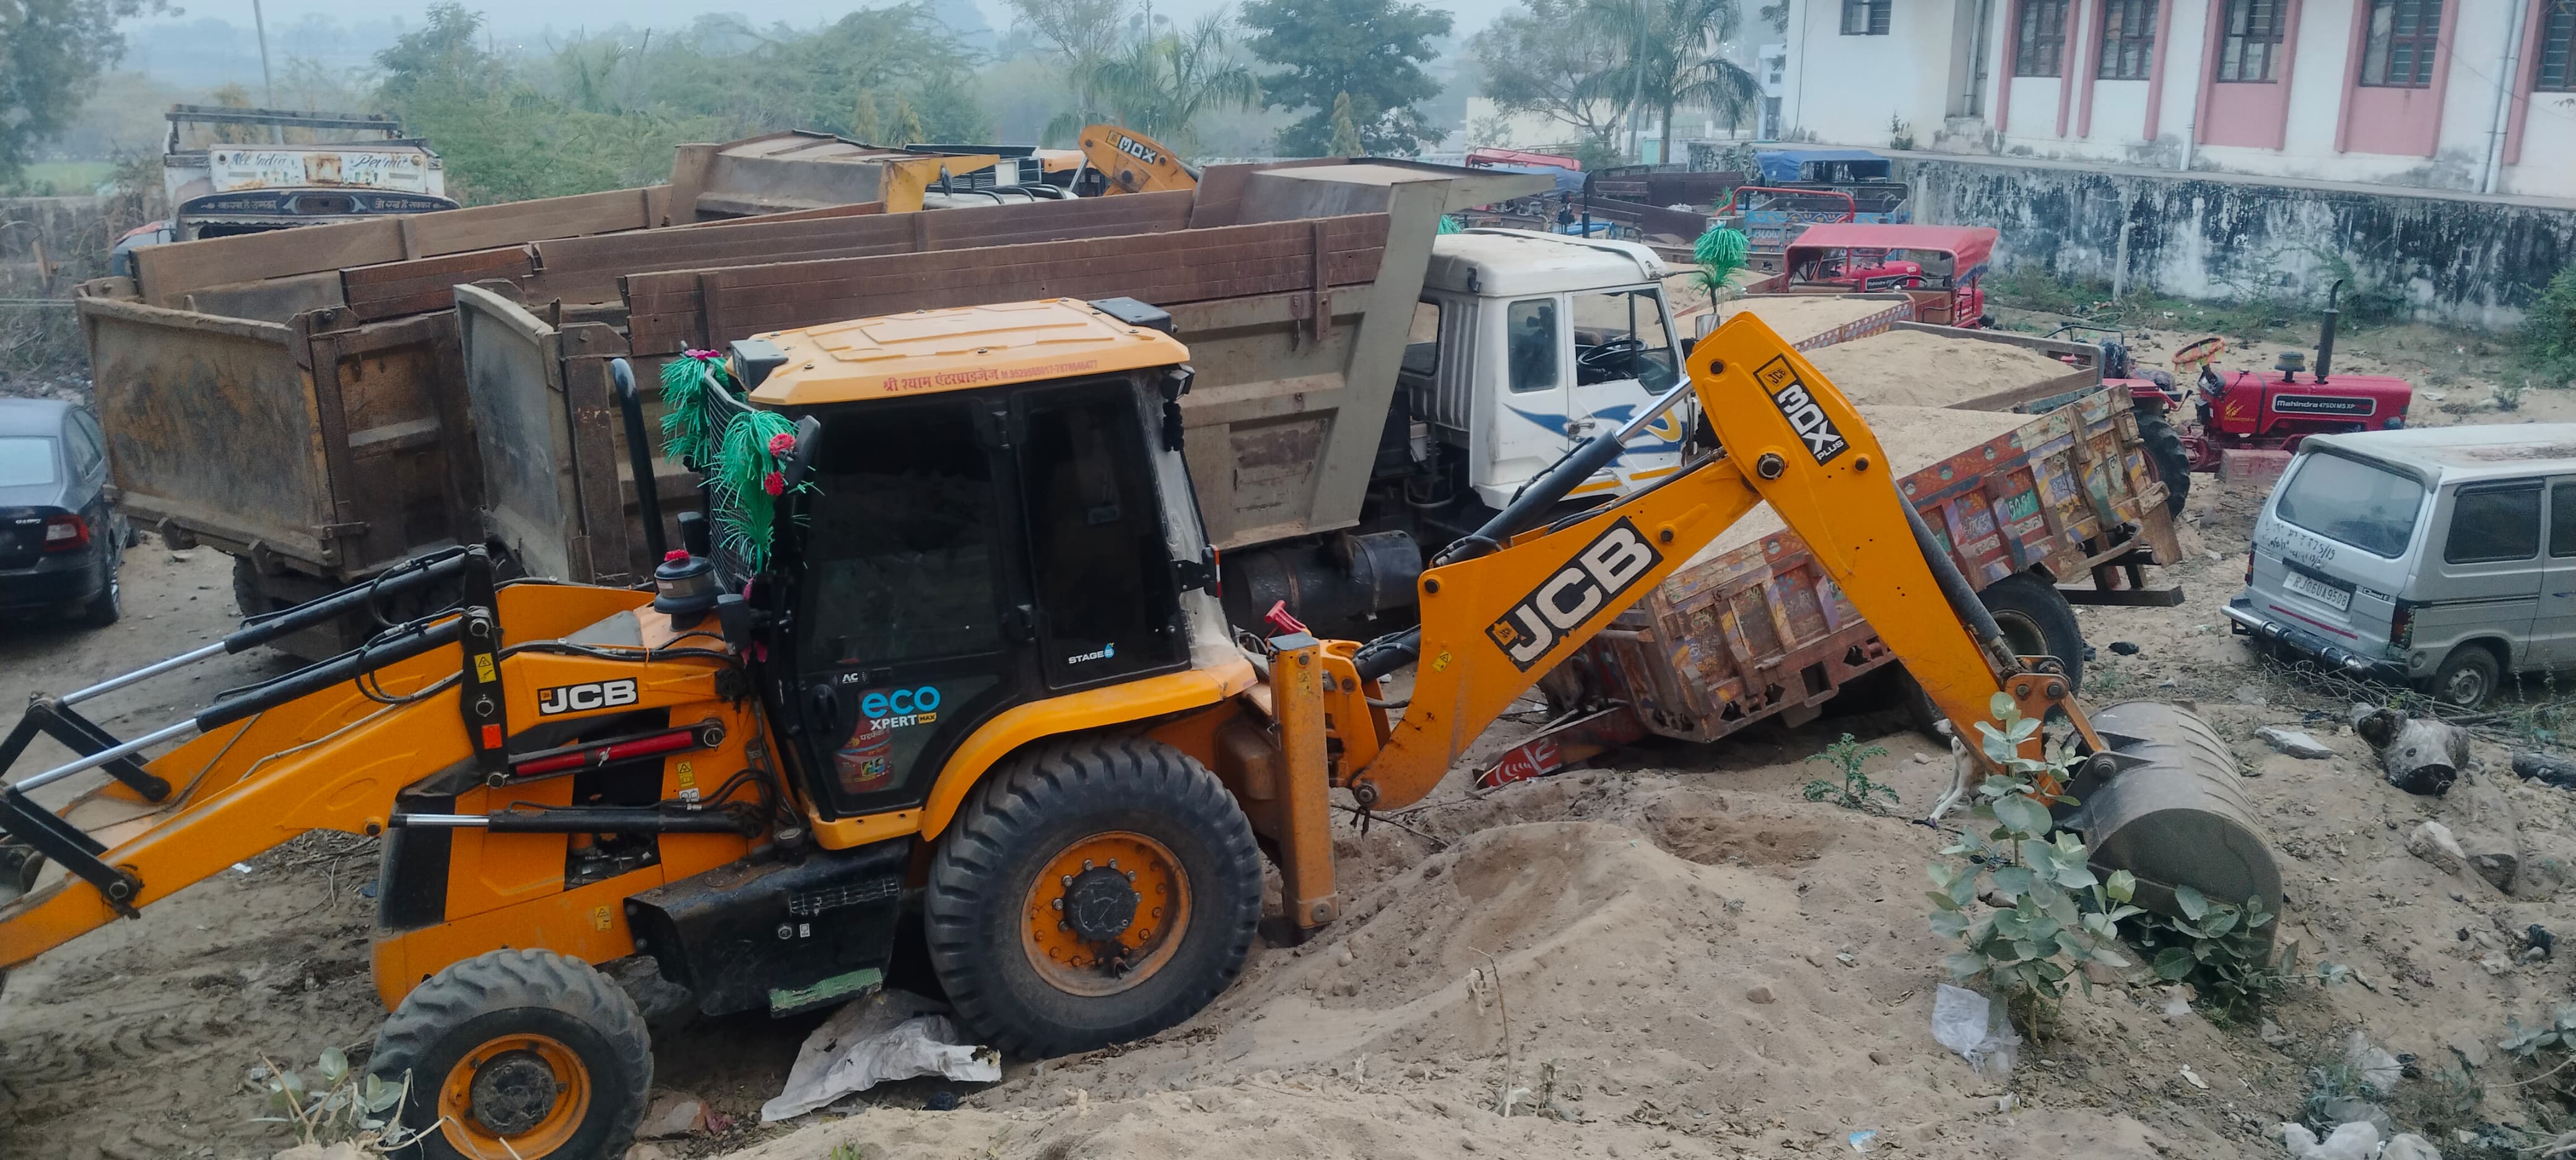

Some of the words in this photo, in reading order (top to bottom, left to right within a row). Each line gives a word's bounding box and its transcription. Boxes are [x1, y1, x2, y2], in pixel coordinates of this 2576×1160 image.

[1118, 136, 1157, 164] 3DX
[884, 377, 898, 391] श्री
[902, 376, 931, 390] श्याम
[1767, 369, 1786, 384] JCB
[2277, 400, 2318, 408] Mahindra
[1778, 384, 1841, 454] 3DX
[1817, 439, 1844, 460] PLUS
[1509, 527, 1652, 662] JCB
[1068, 651, 1104, 664] STAGE
[842, 673, 858, 682] AC
[541, 680, 637, 714] JCB
[862, 685, 941, 718] eco
[870, 714, 917, 730] XPERT
